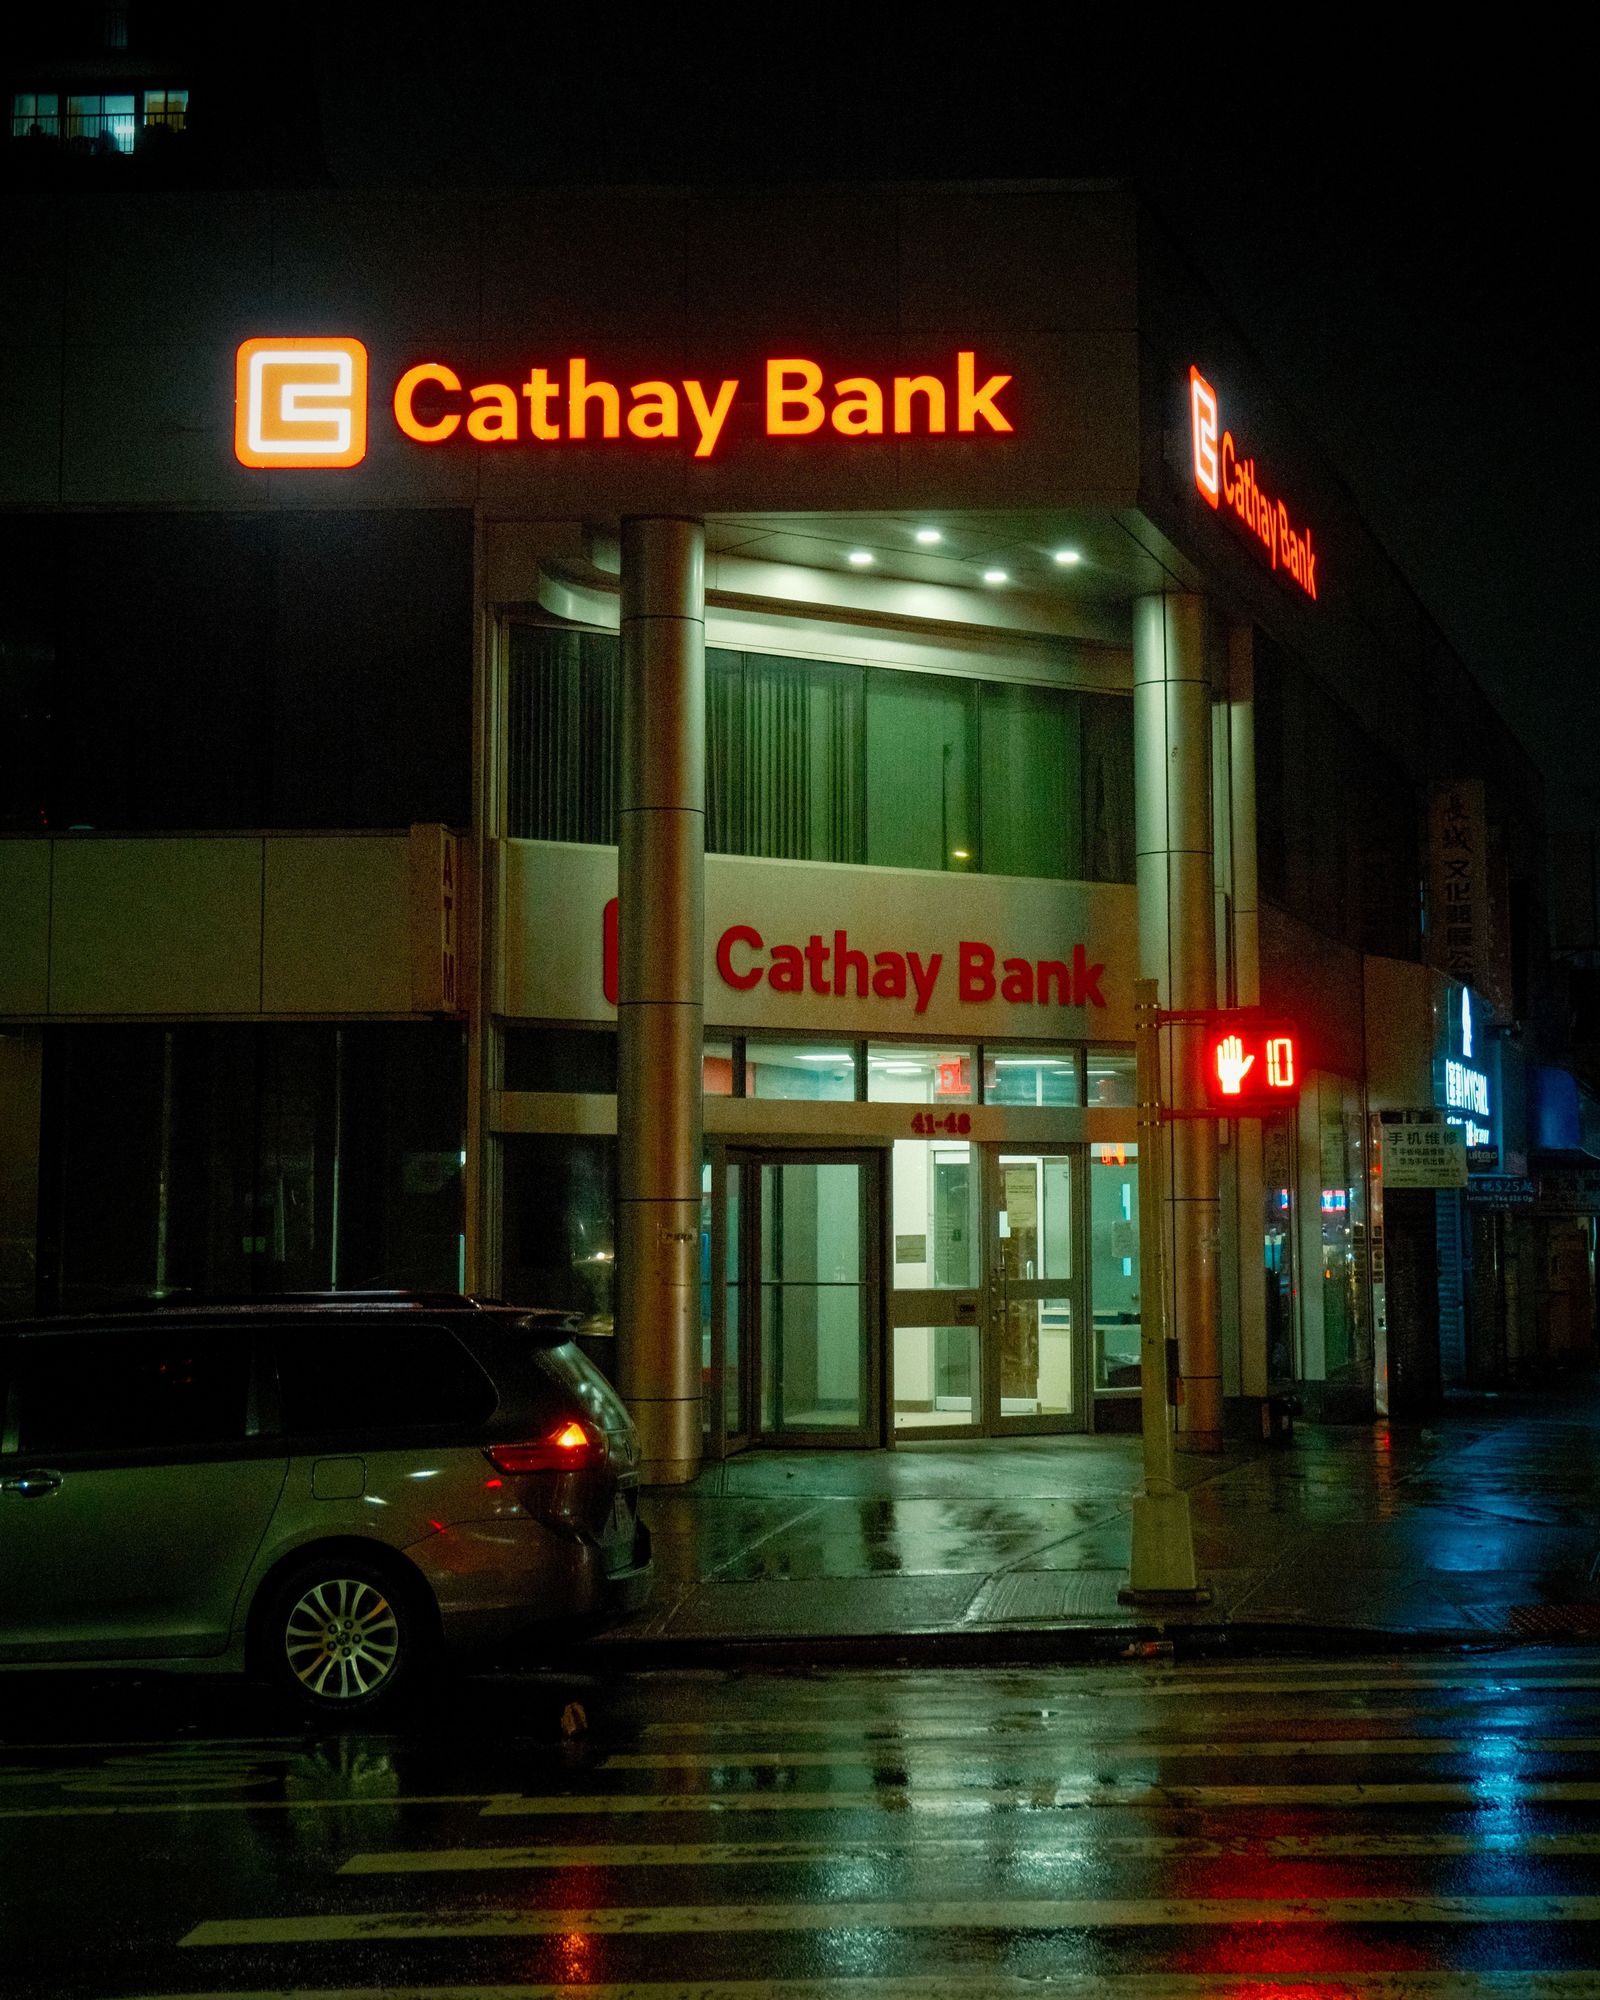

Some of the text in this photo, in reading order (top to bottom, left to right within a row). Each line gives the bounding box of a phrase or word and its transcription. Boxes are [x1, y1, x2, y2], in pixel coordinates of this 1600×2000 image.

[393, 352, 1013, 457] Cathay Bank
[1221, 431, 1318, 601] Cathay Bank
[716, 925, 1106, 1014] Cathay Bank
[1266, 1038, 1295, 1087] 10
[910, 1111, 971, 1134] 41-48
[1388, 1131, 1457, 1145] 手机维修
